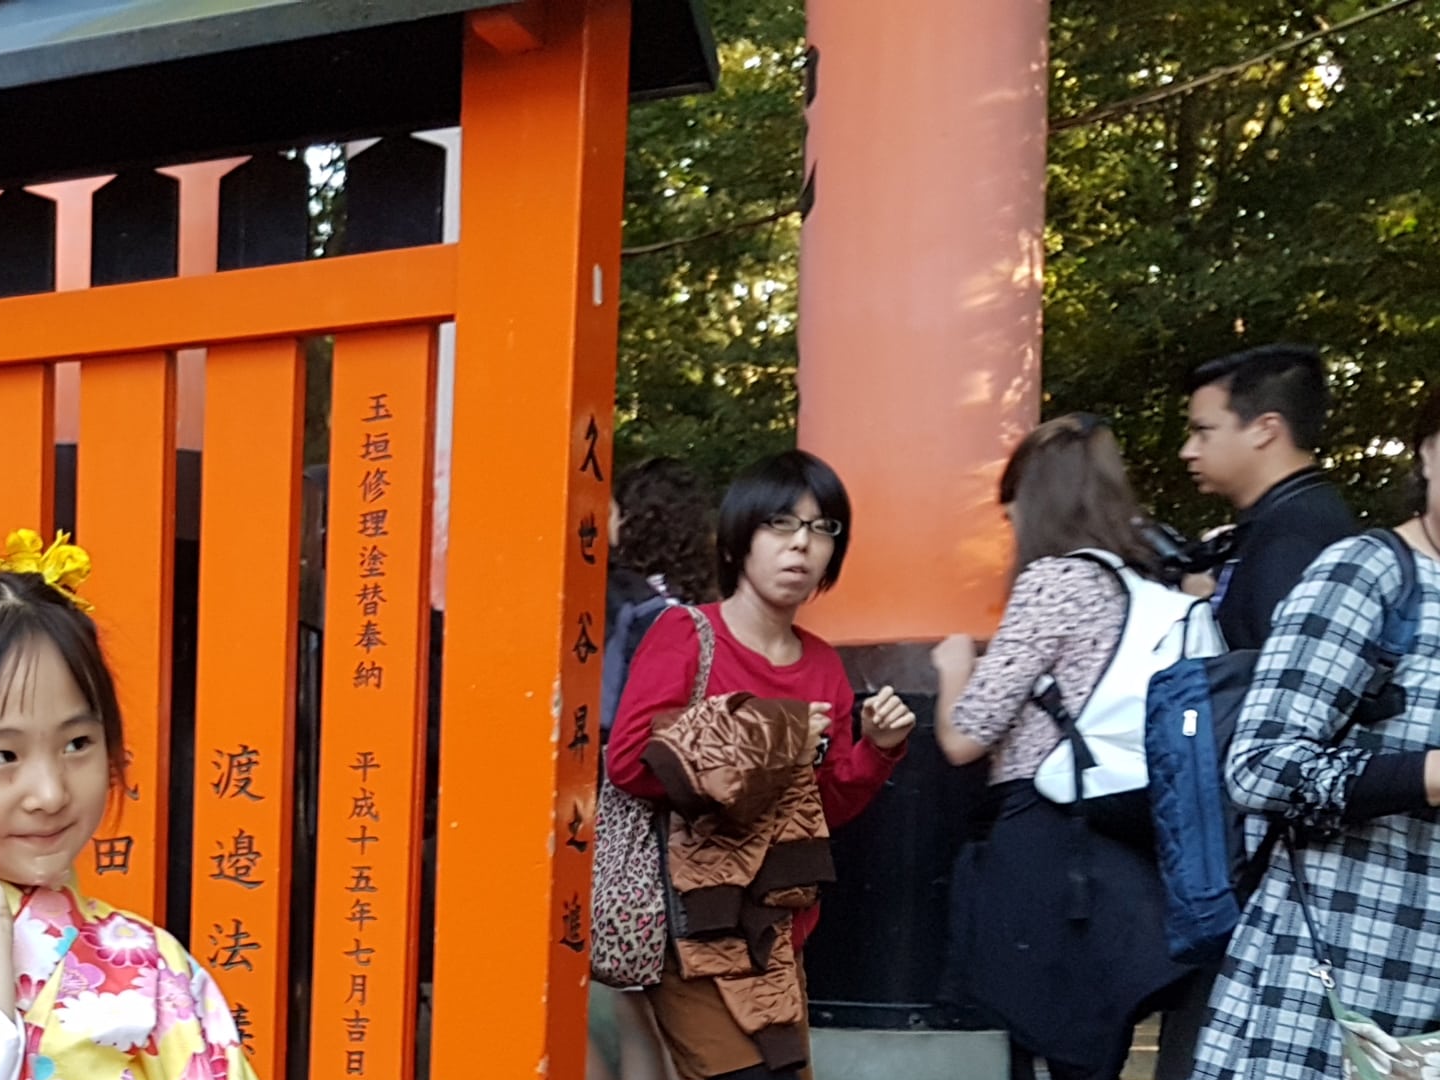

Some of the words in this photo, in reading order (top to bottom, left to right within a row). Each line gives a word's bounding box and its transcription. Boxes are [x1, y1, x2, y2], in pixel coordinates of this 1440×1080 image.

[352, 393, 393, 690] 玉垣修理塗替奉納
[342, 750, 381, 1077] 平成十五年七月吉日
